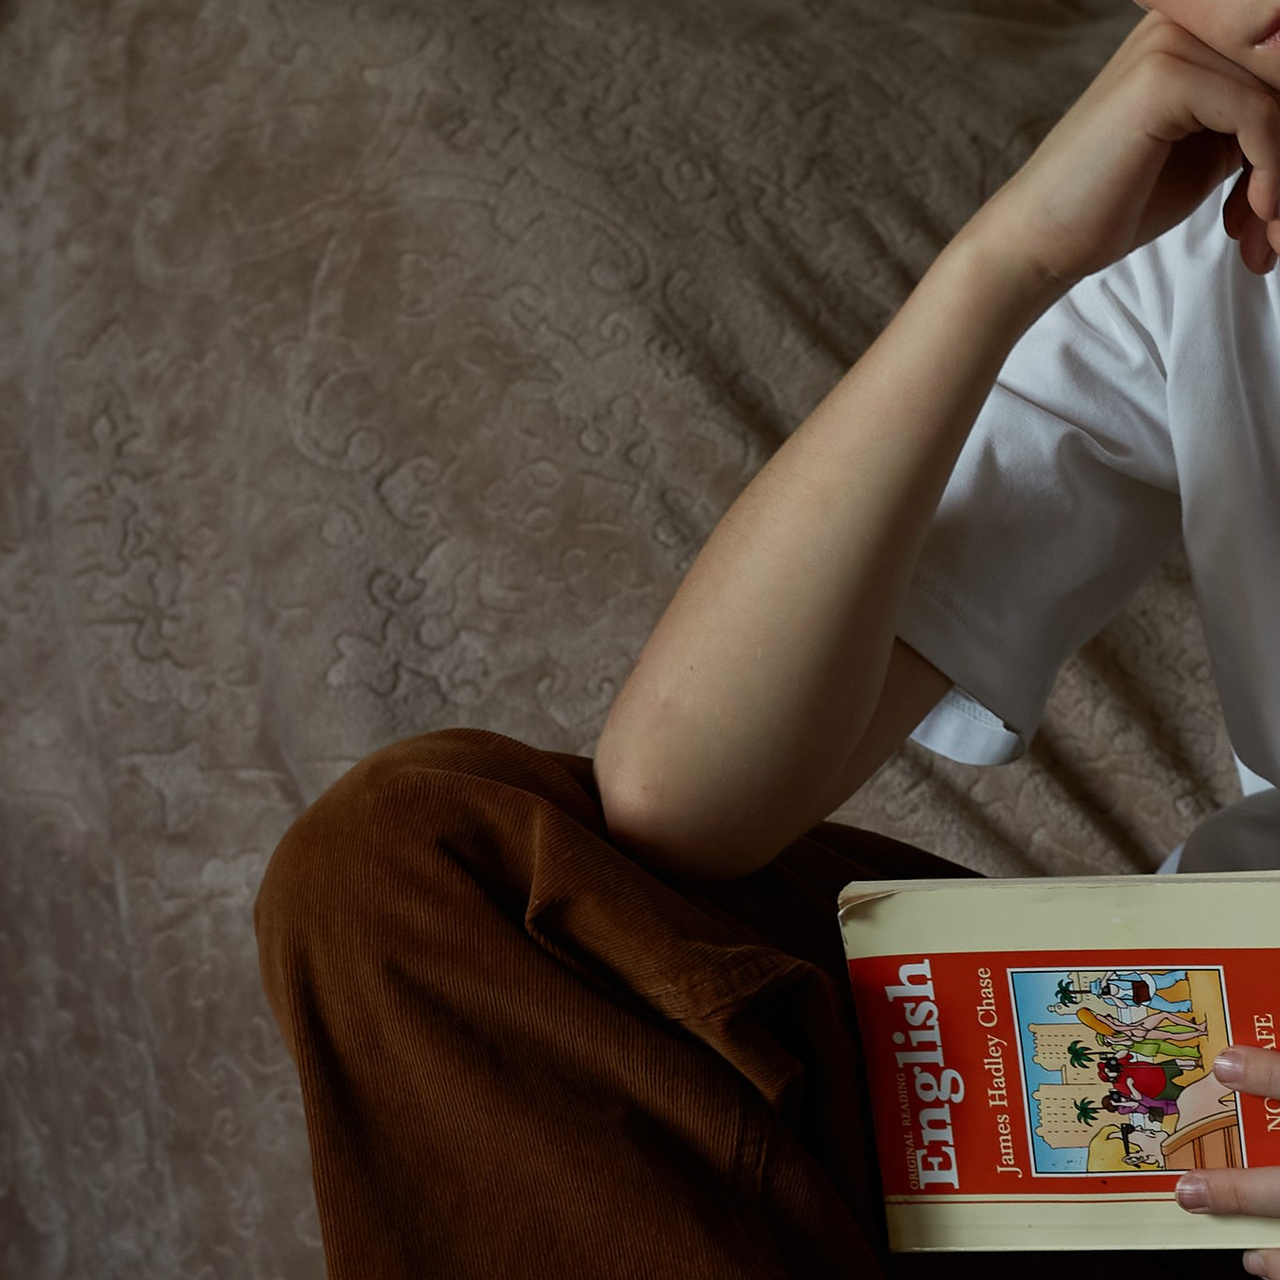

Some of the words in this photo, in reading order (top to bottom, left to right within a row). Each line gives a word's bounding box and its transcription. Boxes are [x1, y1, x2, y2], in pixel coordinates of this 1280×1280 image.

[976, 967, 998, 1028] Chase
[885, 959, 965, 1189] English
[897, 1073, 911, 1126] READING
[983, 1034, 1009, 1107] Hadley
[906, 1131, 920, 1191] ORIGINAL
[996, 1114, 1023, 1179] James
